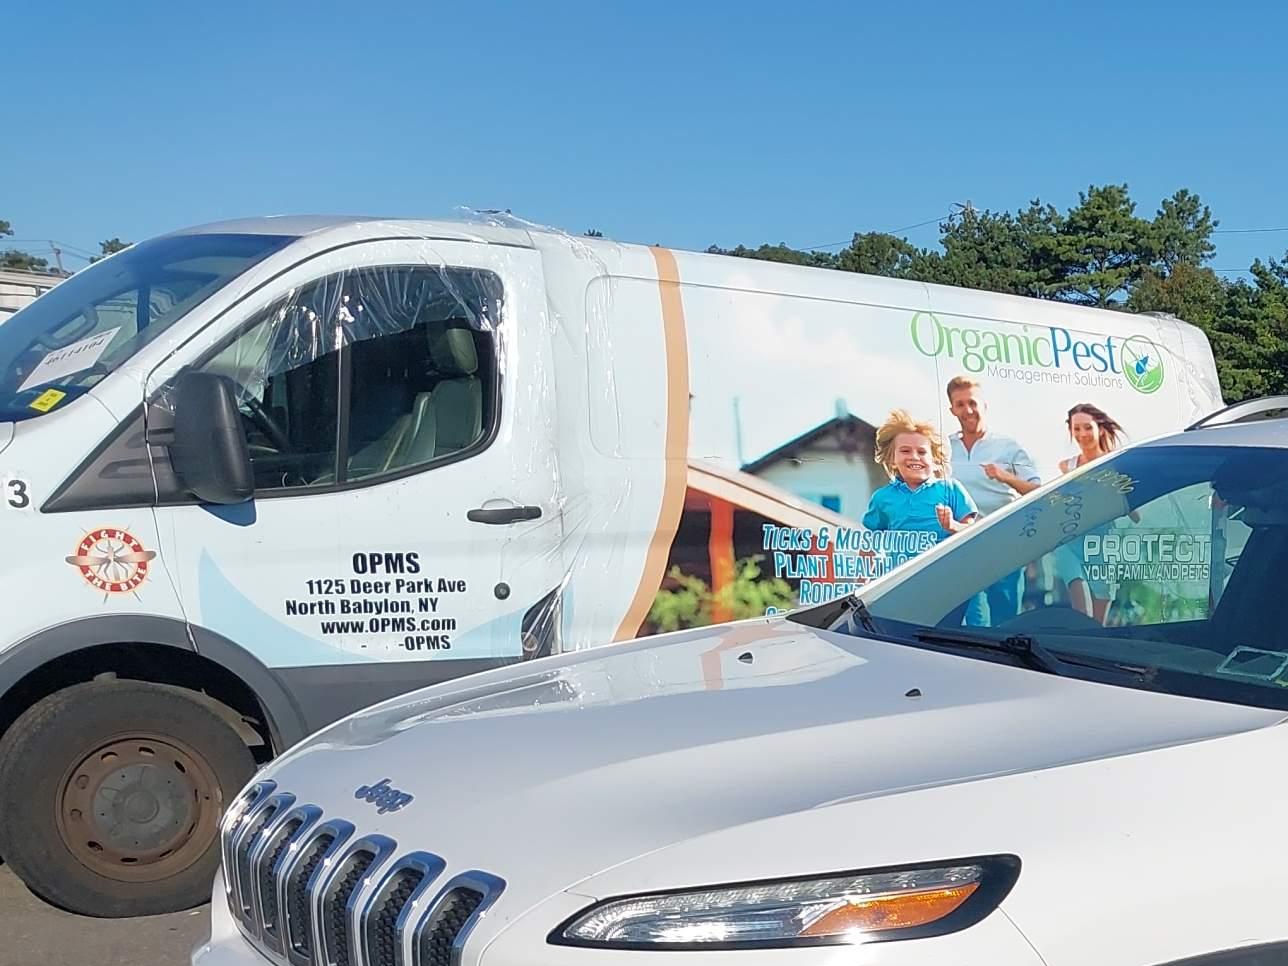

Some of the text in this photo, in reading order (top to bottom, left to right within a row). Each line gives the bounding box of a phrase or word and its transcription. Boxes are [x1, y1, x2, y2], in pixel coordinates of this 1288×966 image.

[987, 366, 1123, 389] Management Solutions
[8, 479, 30, 508] 3
[80, 529, 138, 551] FIGHT
[762, 523, 937, 554] TICKS & MOSQUITOES
[1083, 533, 1211, 563] PROTECT
[352, 552, 421, 574] OPMS
[774, 551, 828, 578] PLANT
[832, 553, 893, 579] HEALTH
[1083, 564, 1209, 580] YOUR FAMILY AND PETS
[84, 567, 147, 591] THE BITE
[306, 577, 467, 595] 1125 Deer Park Ave
[285, 597, 439, 616] North Babylon, NY
[321, 617, 457, 634] www.OPMS.com
